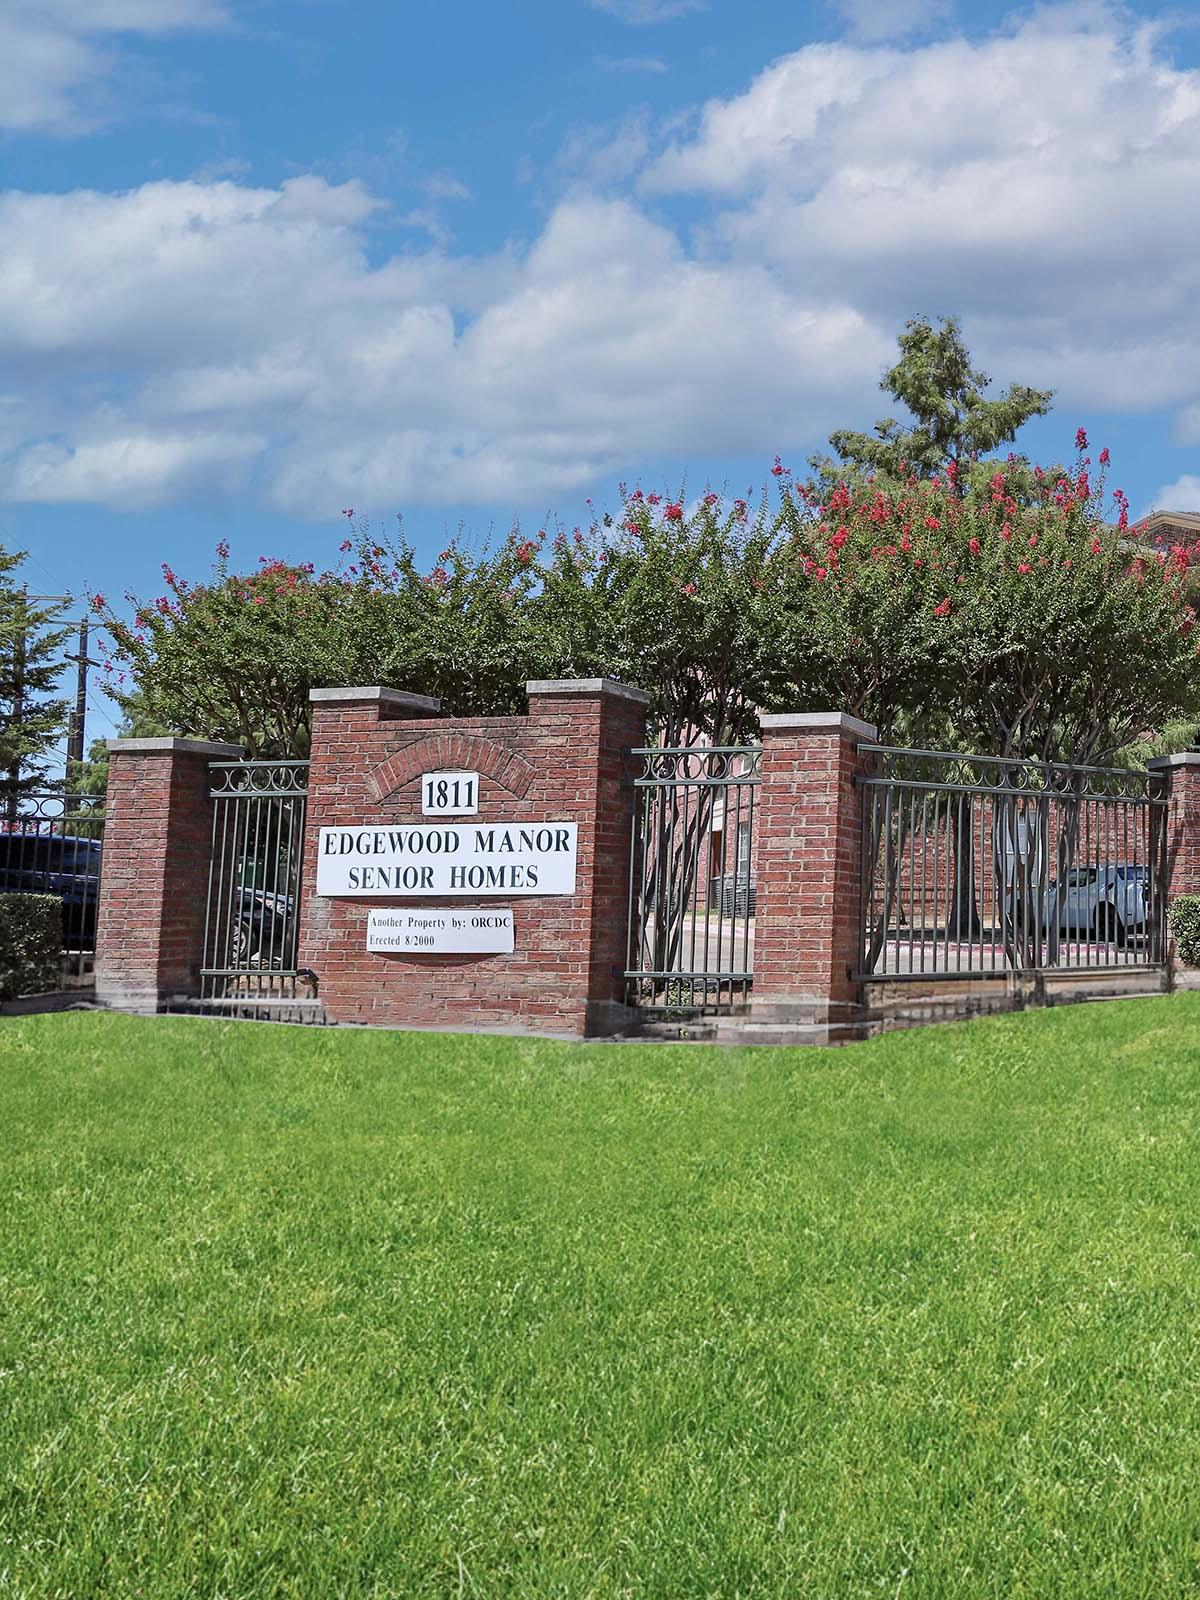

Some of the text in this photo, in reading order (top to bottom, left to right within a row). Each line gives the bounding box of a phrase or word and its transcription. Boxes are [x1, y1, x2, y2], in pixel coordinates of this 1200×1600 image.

[425, 780, 475, 808] 1811
[324, 829, 570, 855] EDGEWOOD MANOR
[348, 865, 539, 889] SENIOR HOMES
[370, 917, 511, 930] Another Property by: ORCDC
[369, 935, 435, 946] Erected 8/2000
